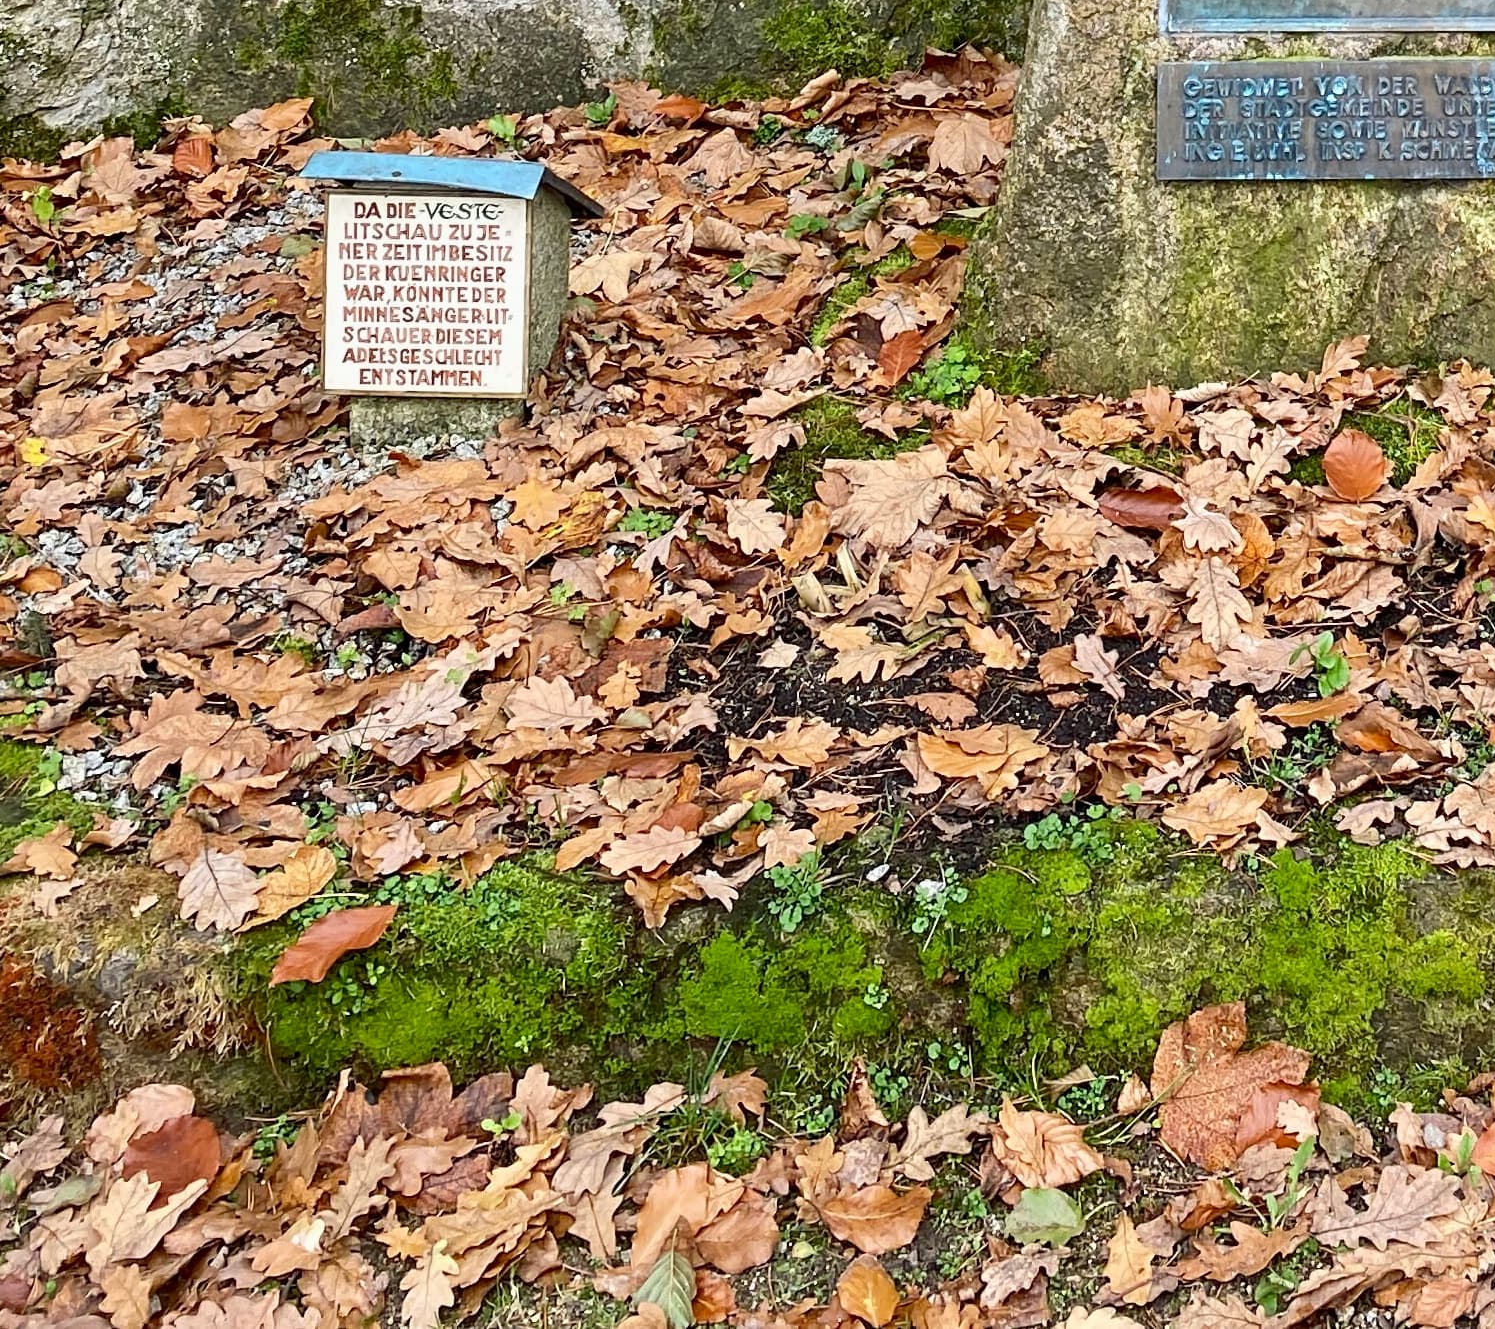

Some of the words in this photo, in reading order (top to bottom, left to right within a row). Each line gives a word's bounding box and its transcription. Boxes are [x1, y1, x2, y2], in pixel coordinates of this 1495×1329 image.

[1183, 76, 1303, 97] GEWIDMET
[1314, 75, 1364, 96] VON
[1378, 75, 1417, 95] DER
[1184, 98, 1225, 118] DER
[1240, 97, 1425, 118] STADTGEMEINDE
[1184, 119, 1303, 140] INITIATIVE
[1316, 120, 1387, 140] SOWIE
[354, 202, 382, 219] DA
[386, 202, 417, 219] DIE
[344, 222, 443, 240] LITSCHAU
[449, 224, 473, 240] ZU
[339, 242, 378, 260] NER
[382, 244, 422, 261] ZEIT
[426, 244, 446, 261] IM
[449, 244, 513, 262] BESITZ
[343, 263, 381, 281] DER
[385, 265, 507, 283] KUENRINGER
[343, 284, 391, 305] WAR,
[393, 283, 469, 303] KÖNNTE
[471, 286, 507, 304] DER
[436, 328, 503, 346] DIESEM
